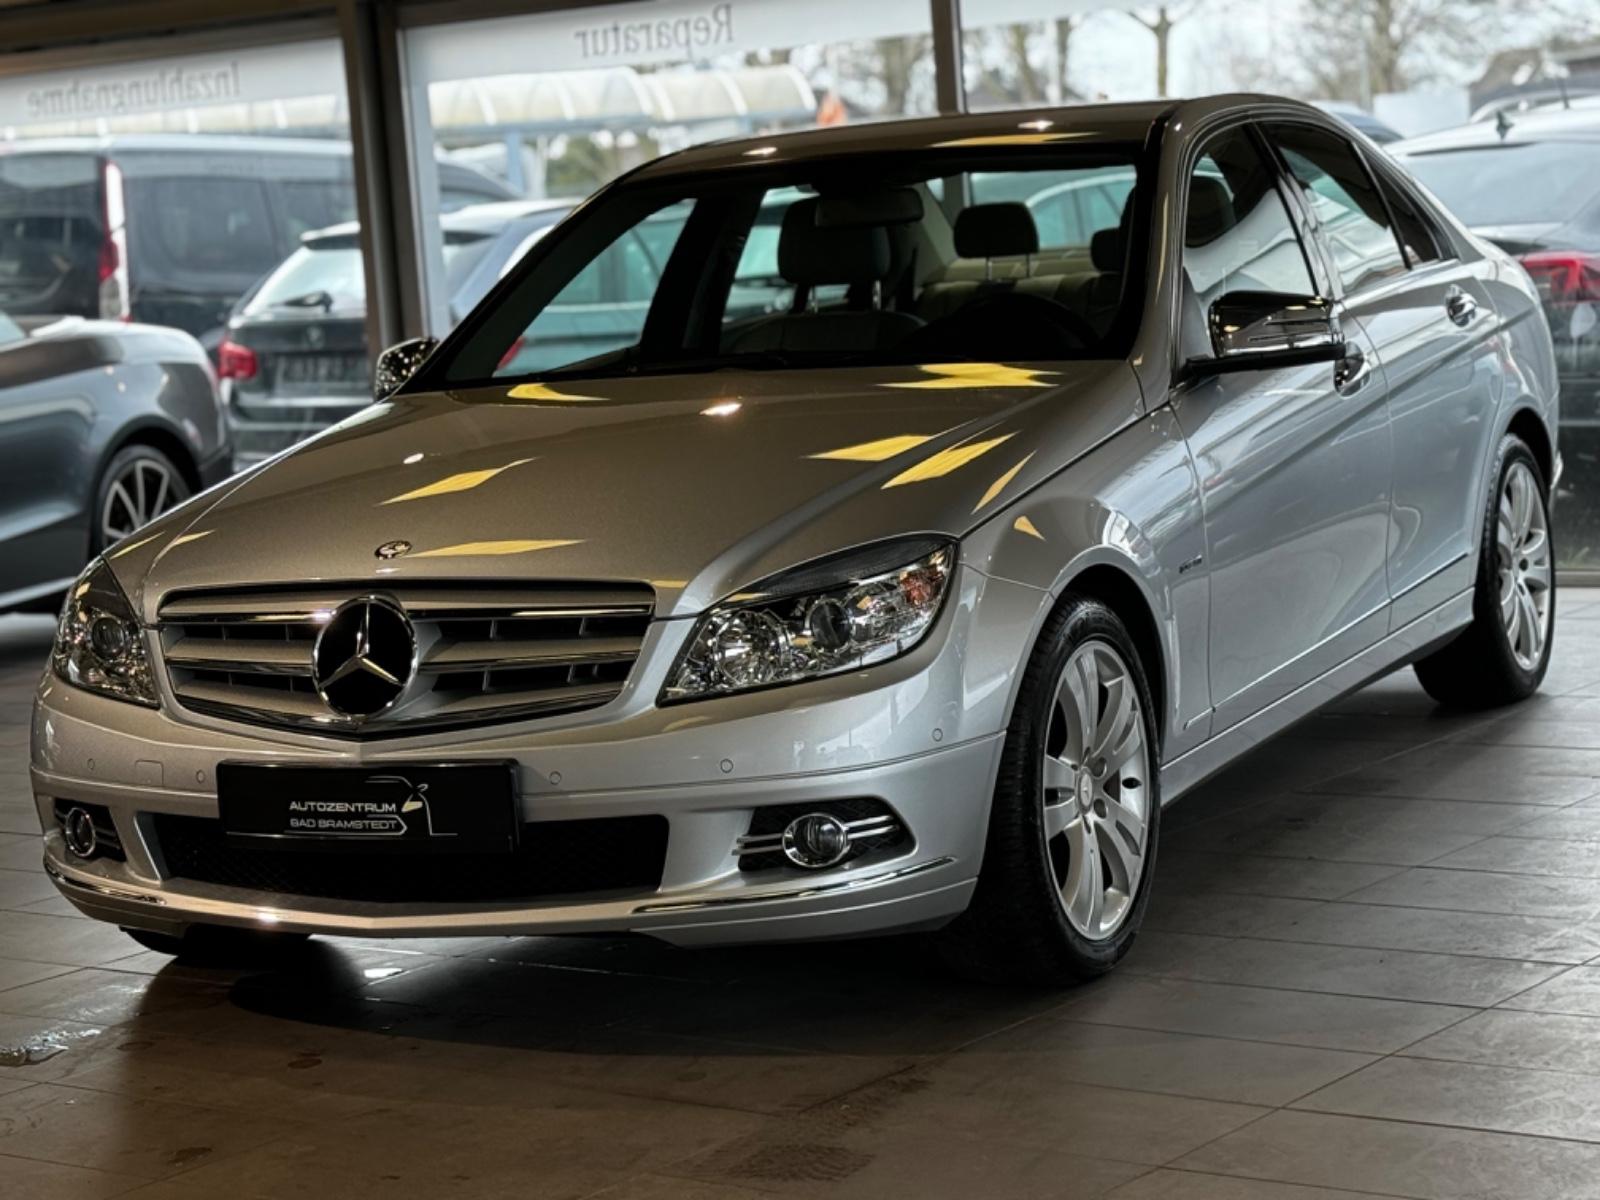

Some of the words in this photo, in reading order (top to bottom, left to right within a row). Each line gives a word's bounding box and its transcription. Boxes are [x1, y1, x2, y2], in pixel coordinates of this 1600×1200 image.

[289, 801, 397, 813] AUTOZENTRUM
[290, 818, 316, 829] BAD
[318, 818, 397, 830] BRAMSTEDT
